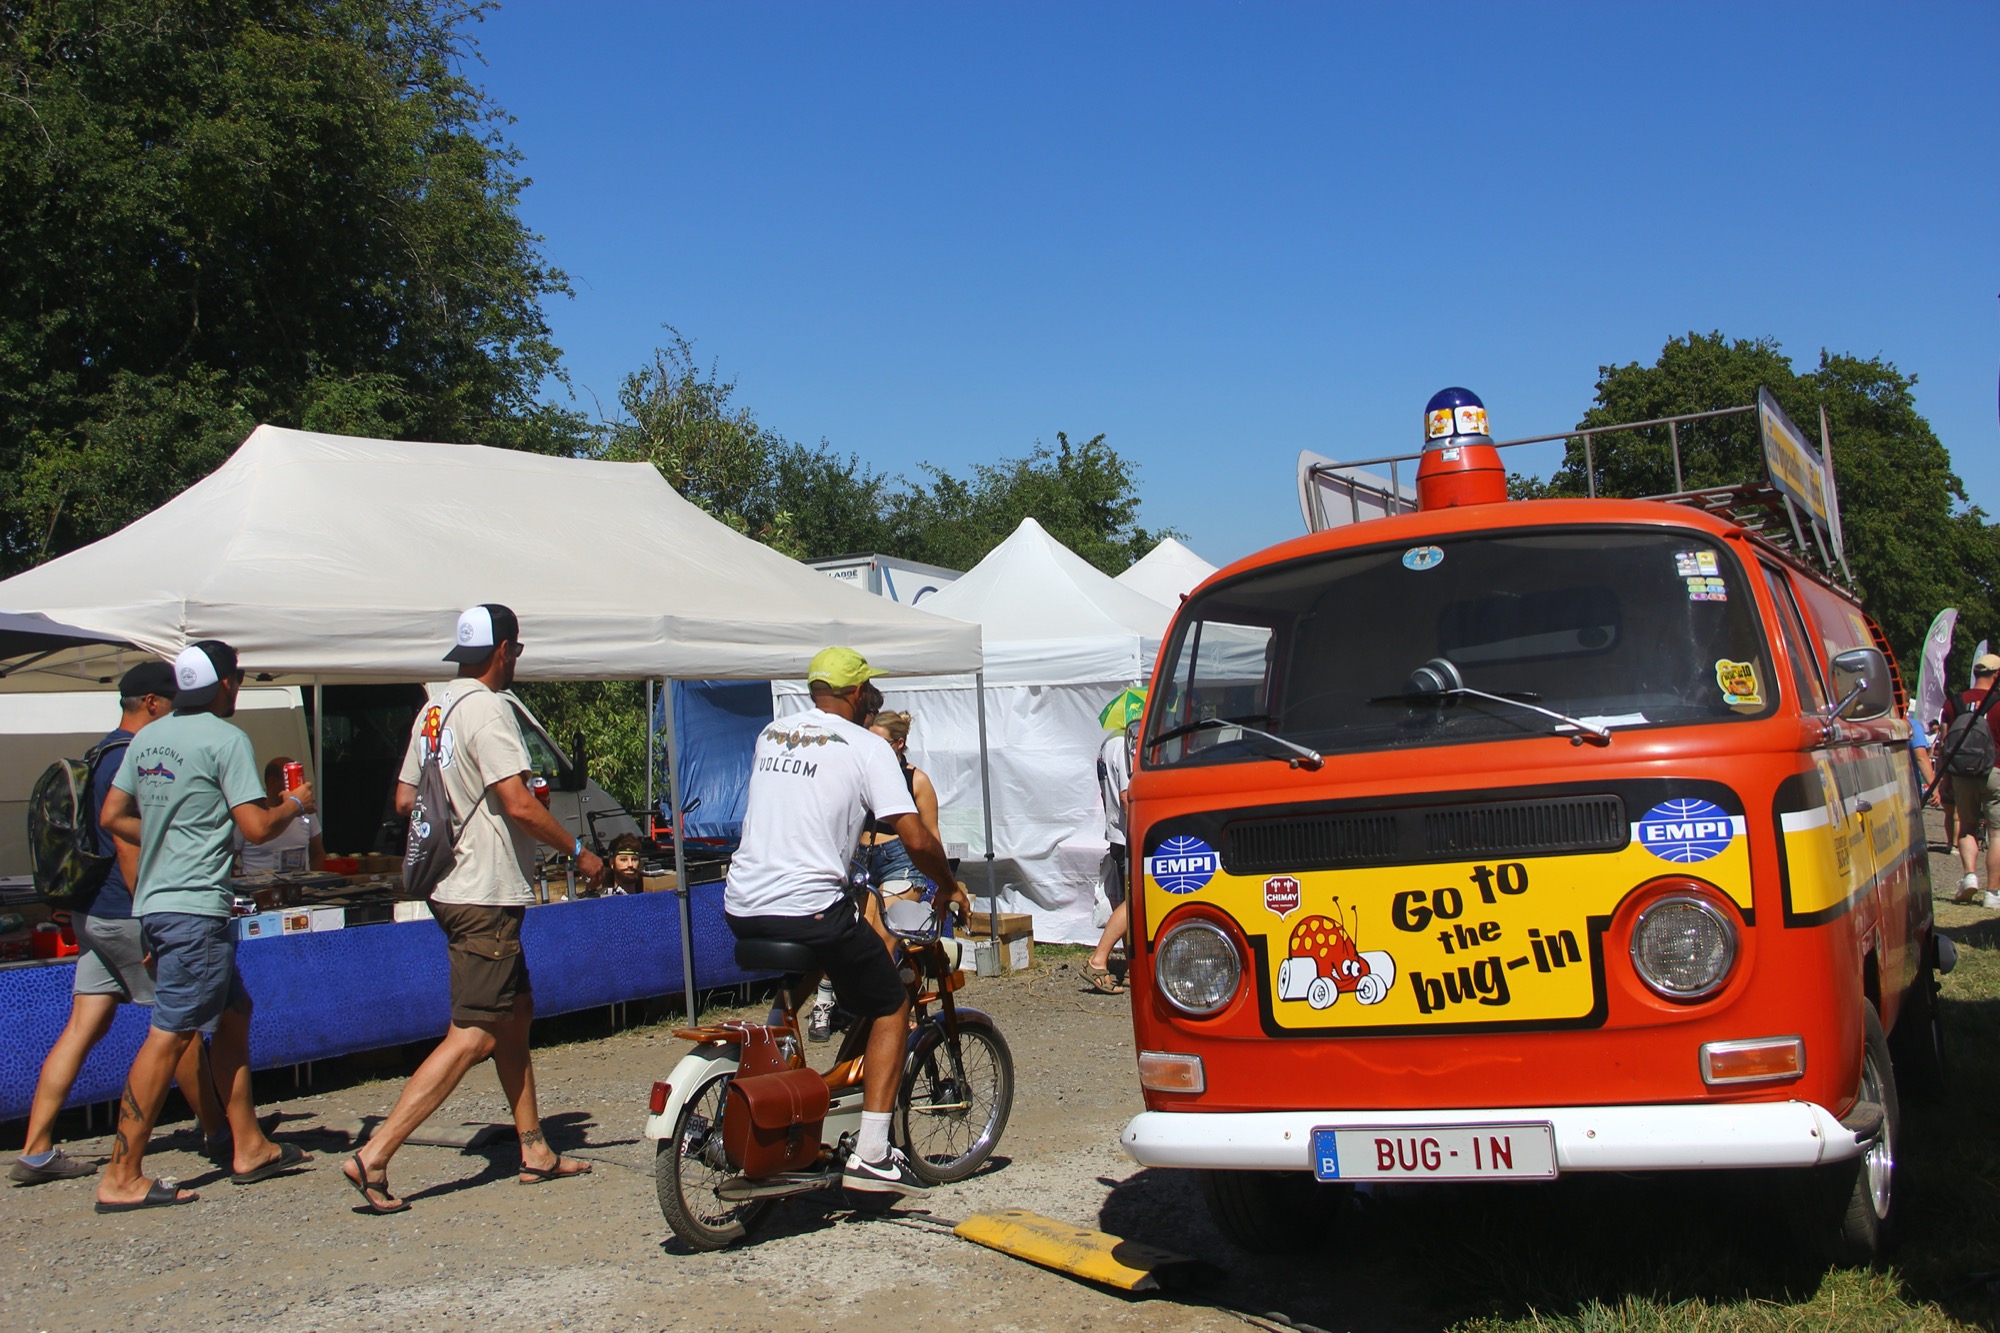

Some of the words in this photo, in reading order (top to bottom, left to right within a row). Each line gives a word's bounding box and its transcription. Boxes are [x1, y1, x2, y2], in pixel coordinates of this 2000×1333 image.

[135, 746, 184, 767] PATAGONIA
[759, 757, 818, 778] VOLCOM
[1646, 821, 1727, 841] EMPI
[1156, 857, 1211, 874] EMPI
[1266, 893, 1298, 901] CHIMAY
[1391, 887, 1463, 932] Go
[1469, 862, 1529, 904] to
[1436, 921, 1502, 954] the
[1408, 928, 1583, 1014] bug-in
[1322, 1158, 1336, 1173] B
